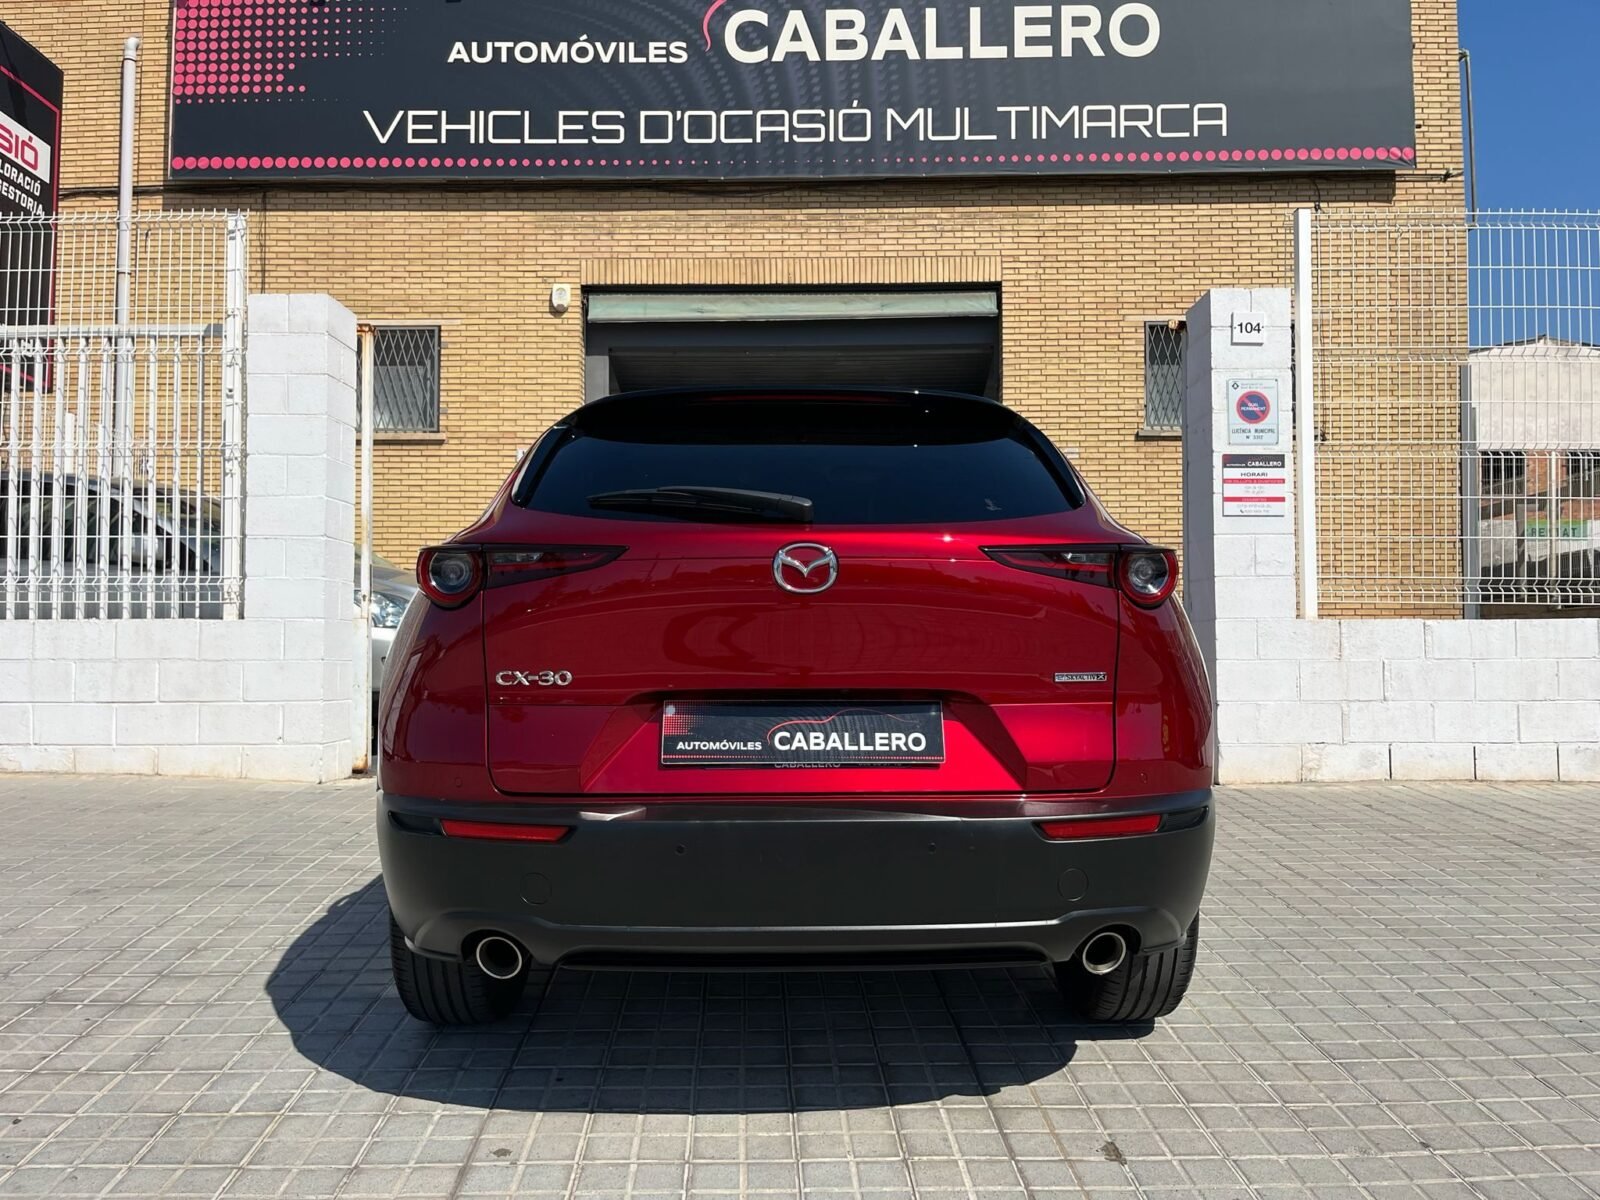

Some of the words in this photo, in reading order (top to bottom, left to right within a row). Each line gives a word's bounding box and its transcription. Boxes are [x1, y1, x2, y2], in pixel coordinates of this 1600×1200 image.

[447, 34, 688, 64] AUTOMÓVILES
[724, 2, 1161, 64] CABALLERO
[362, 109, 626, 145] VEHICLES
[886, 102, 1228, 142] MULTIMARCA
[1237, 321, 1262, 334] 104
[495, 670, 573, 686] CX-30
[676, 739, 762, 751] AUTOMÓVILES
[774, 731, 927, 752] CABALLERO
